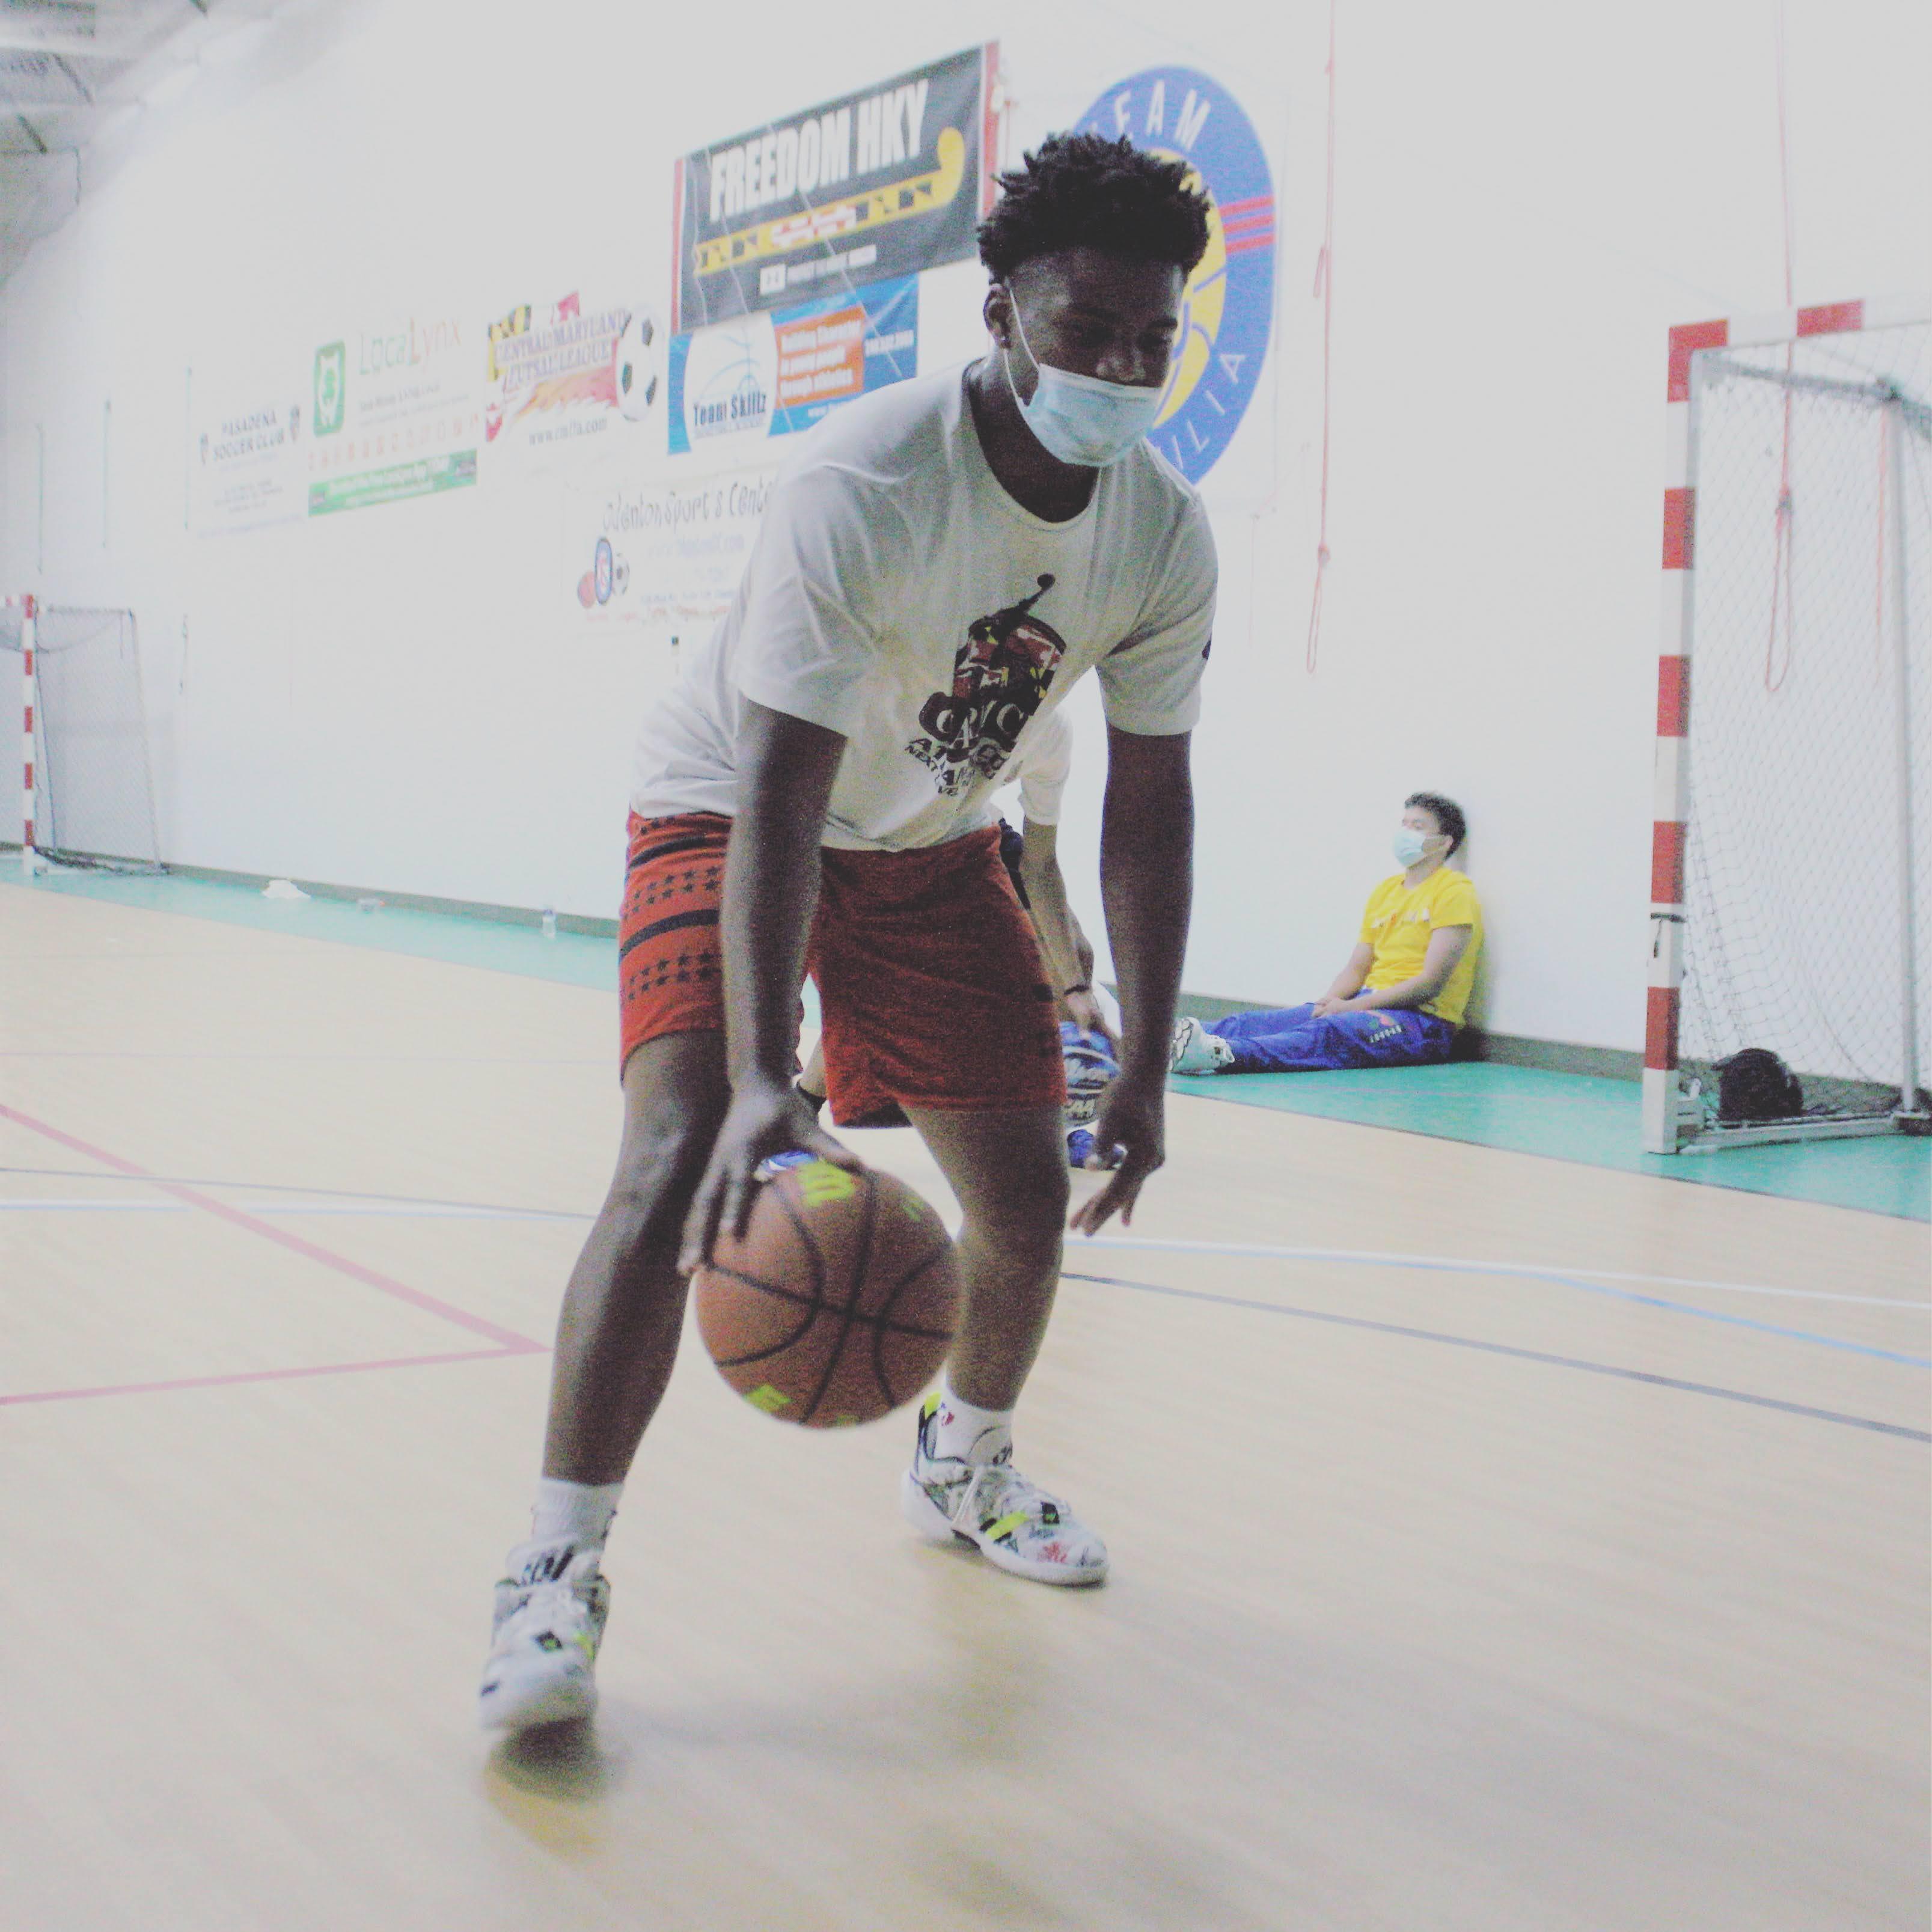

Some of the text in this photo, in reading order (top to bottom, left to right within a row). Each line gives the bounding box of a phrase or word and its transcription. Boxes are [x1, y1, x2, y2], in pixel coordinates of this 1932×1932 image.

[1090, 79, 1211, 152] EAM
[710, 79, 928, 223] FREEDOM HKY
[558, 340, 610, 371] LEAGUE
[693, 400, 727, 427] Team
